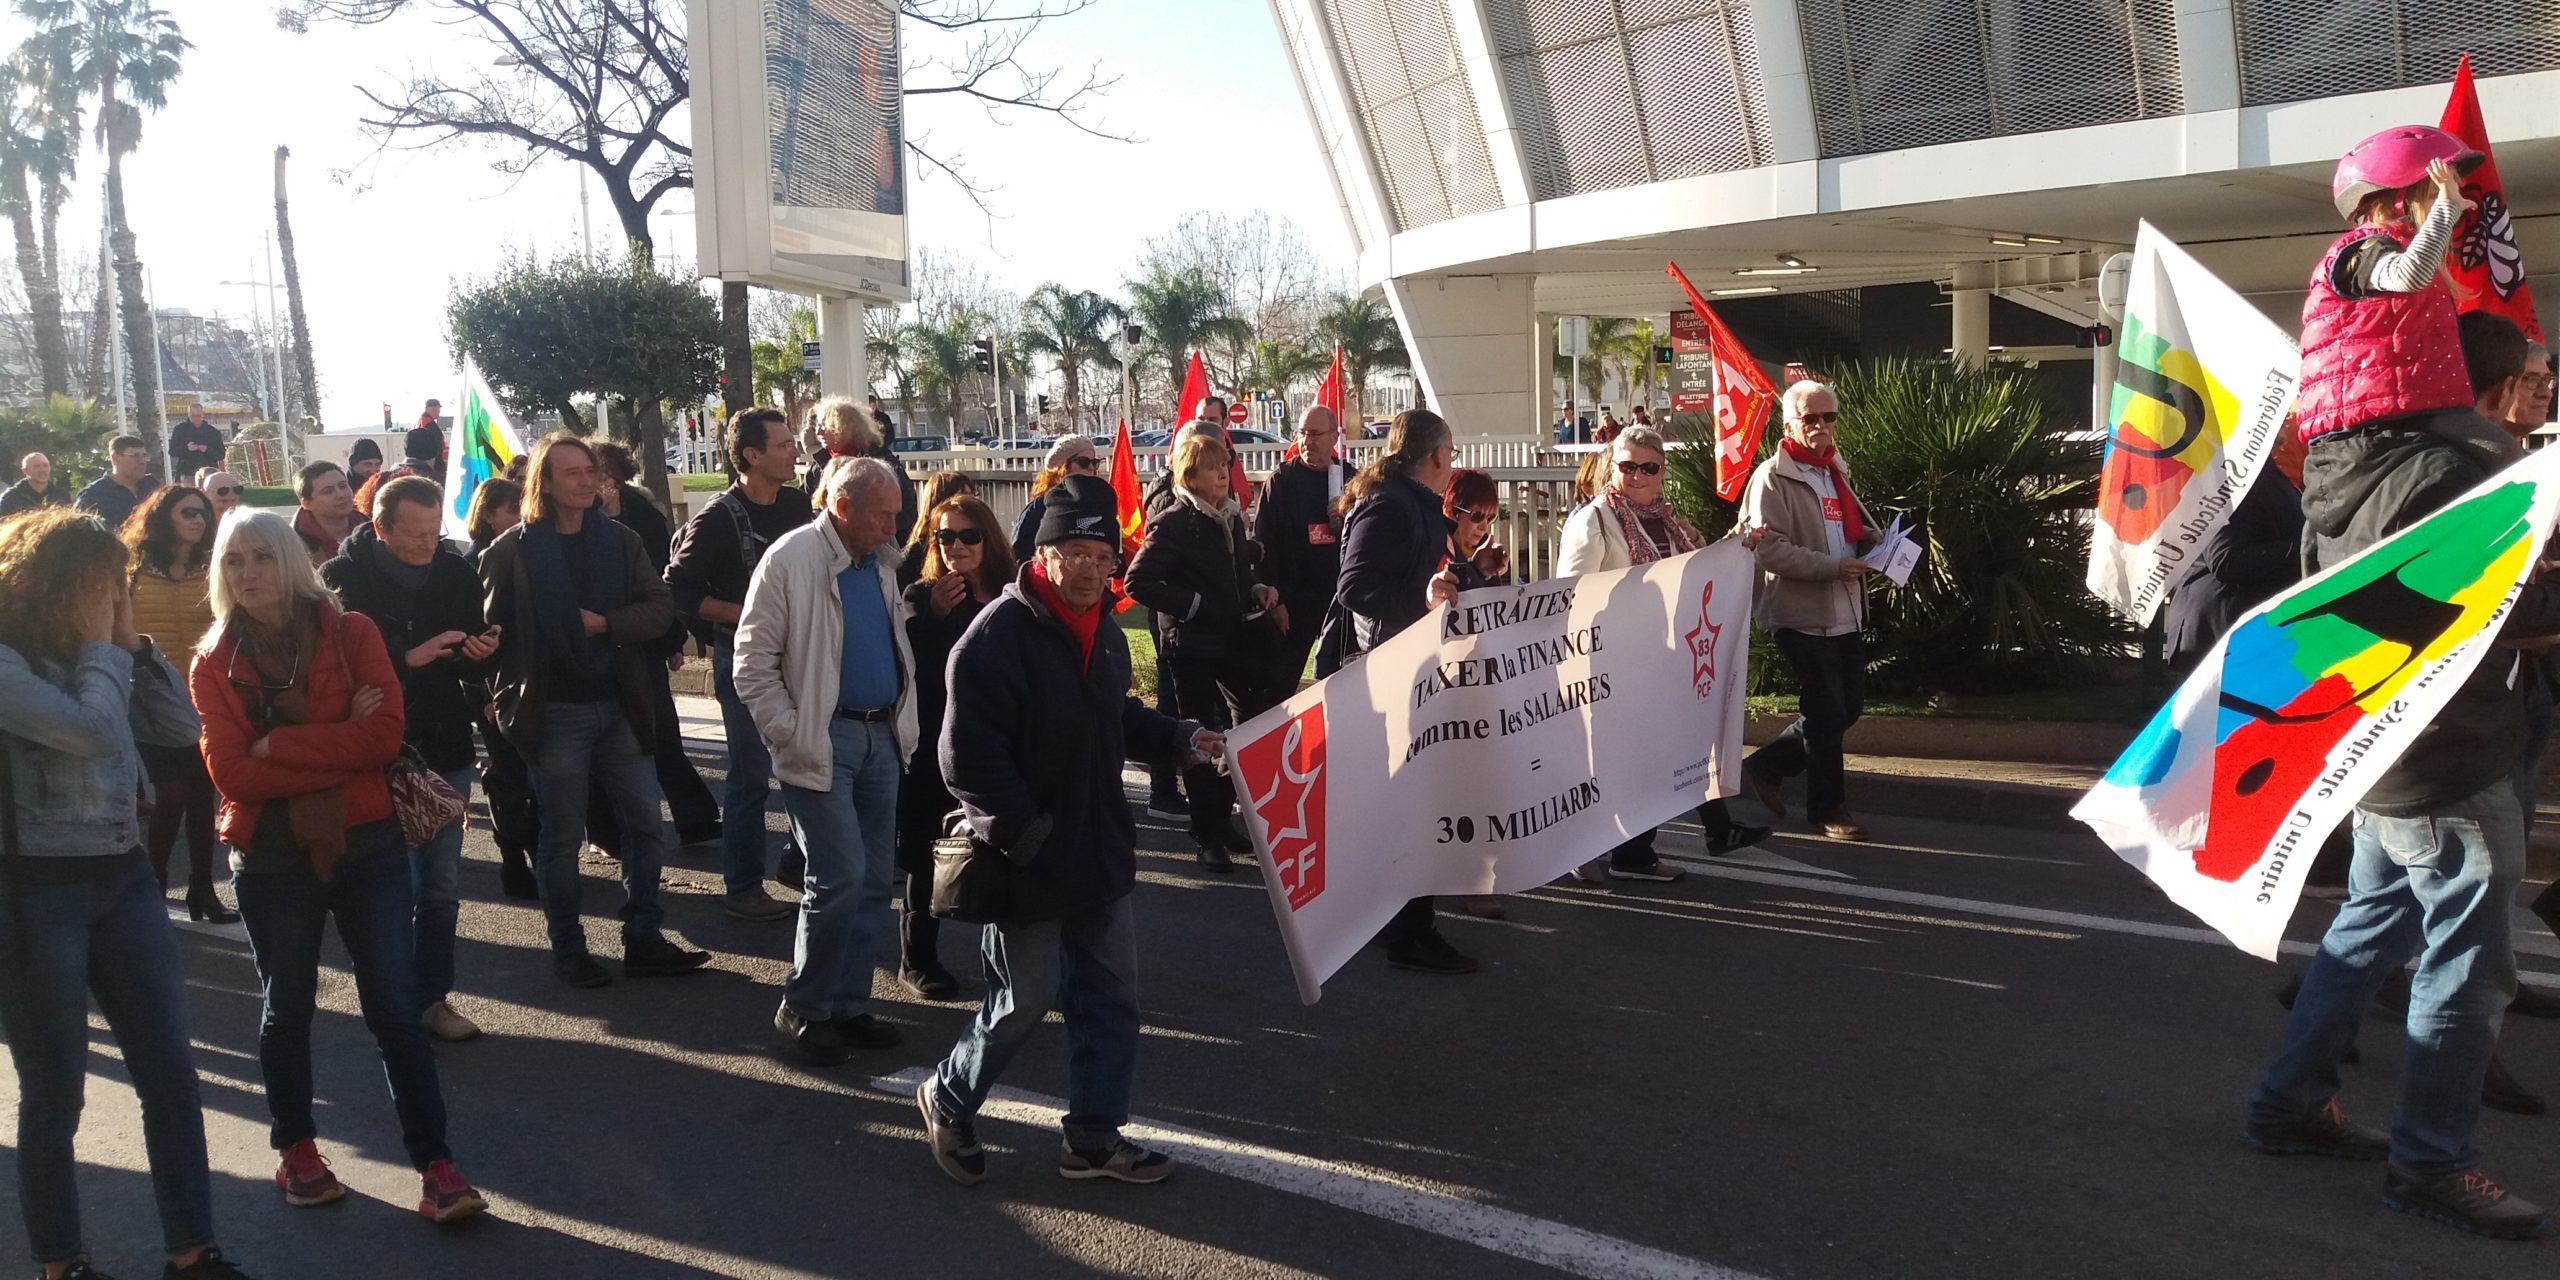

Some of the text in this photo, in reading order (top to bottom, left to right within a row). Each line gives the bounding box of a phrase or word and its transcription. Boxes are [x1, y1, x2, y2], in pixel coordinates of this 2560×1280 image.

[1675, 360, 1712, 369] LAFONTAN
[1679, 353, 1709, 361] TRIBUNE
[1681, 379, 1707, 388] ENTRÉE
[1081, 529, 1105, 537] ZEALAND
[1444, 587, 1576, 639] RETRAITES:
[1698, 638, 1710, 657] 83
[1414, 625, 1603, 710] TAXER la FINANCE
[1697, 680, 1712, 700] PCF
[1406, 672, 1611, 763] comme les SALAIRES
[1436, 777, 1601, 844] 30 MILLIARDS
